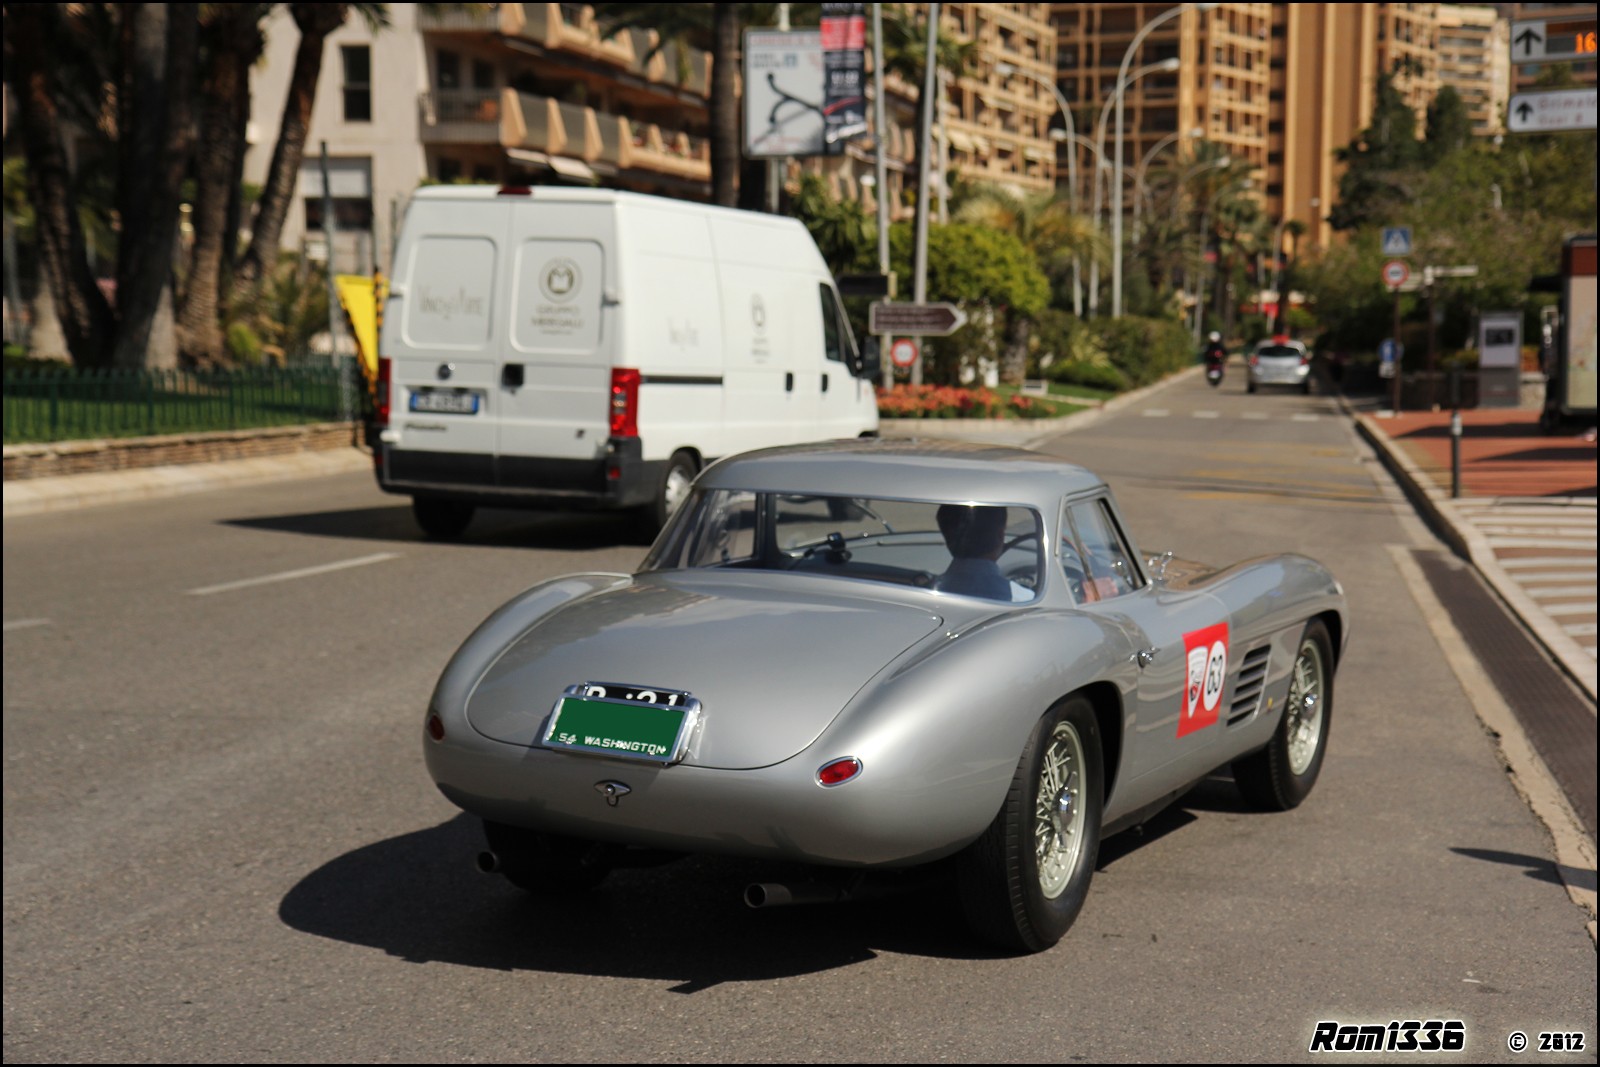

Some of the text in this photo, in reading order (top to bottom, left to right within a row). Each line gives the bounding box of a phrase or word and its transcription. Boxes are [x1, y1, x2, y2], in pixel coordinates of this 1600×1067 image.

[1575, 31, 1597, 54] 16
[1207, 654, 1223, 695] 63
[584, 735, 667, 755] WASHINGTON
